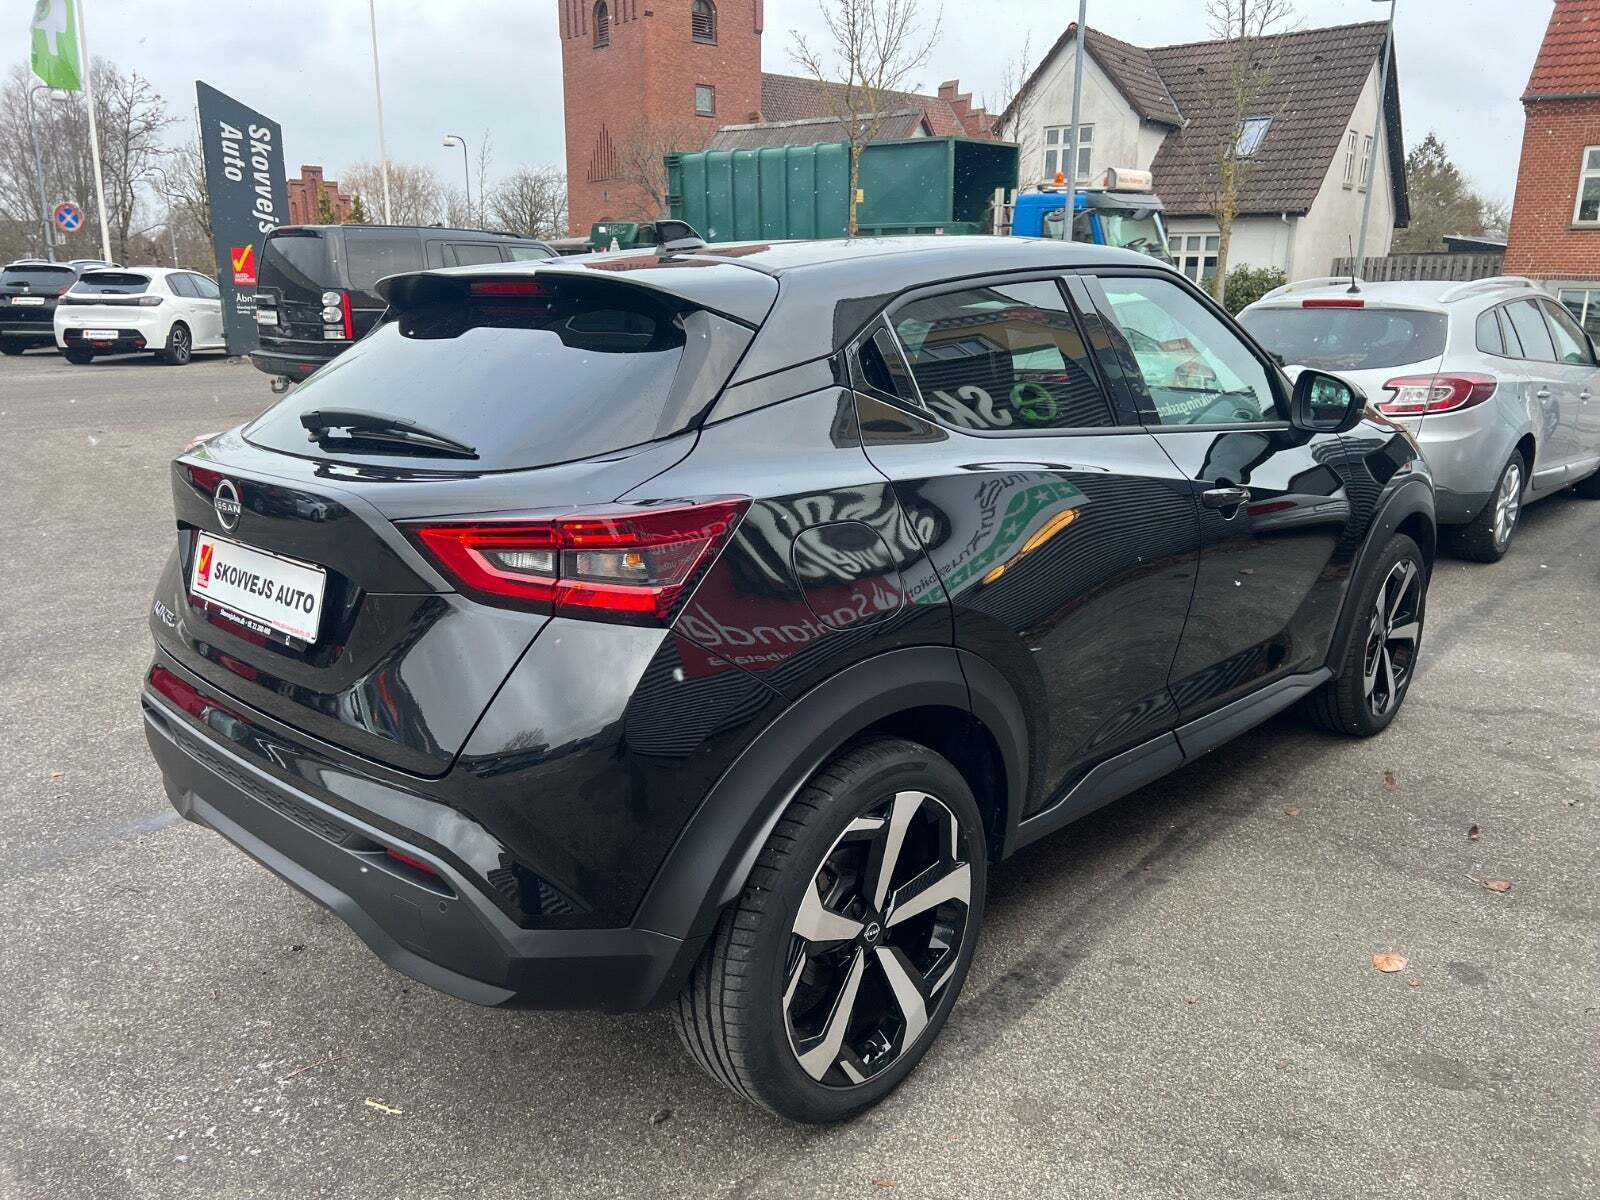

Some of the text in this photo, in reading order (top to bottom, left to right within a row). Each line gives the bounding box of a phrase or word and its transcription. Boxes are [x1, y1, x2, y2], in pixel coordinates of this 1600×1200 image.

[220, 120, 246, 182] Auto
[249, 124, 280, 233] Skovvejs
[214, 561, 275, 599] SKOVVEJS
[275, 584, 316, 614] AUTO
